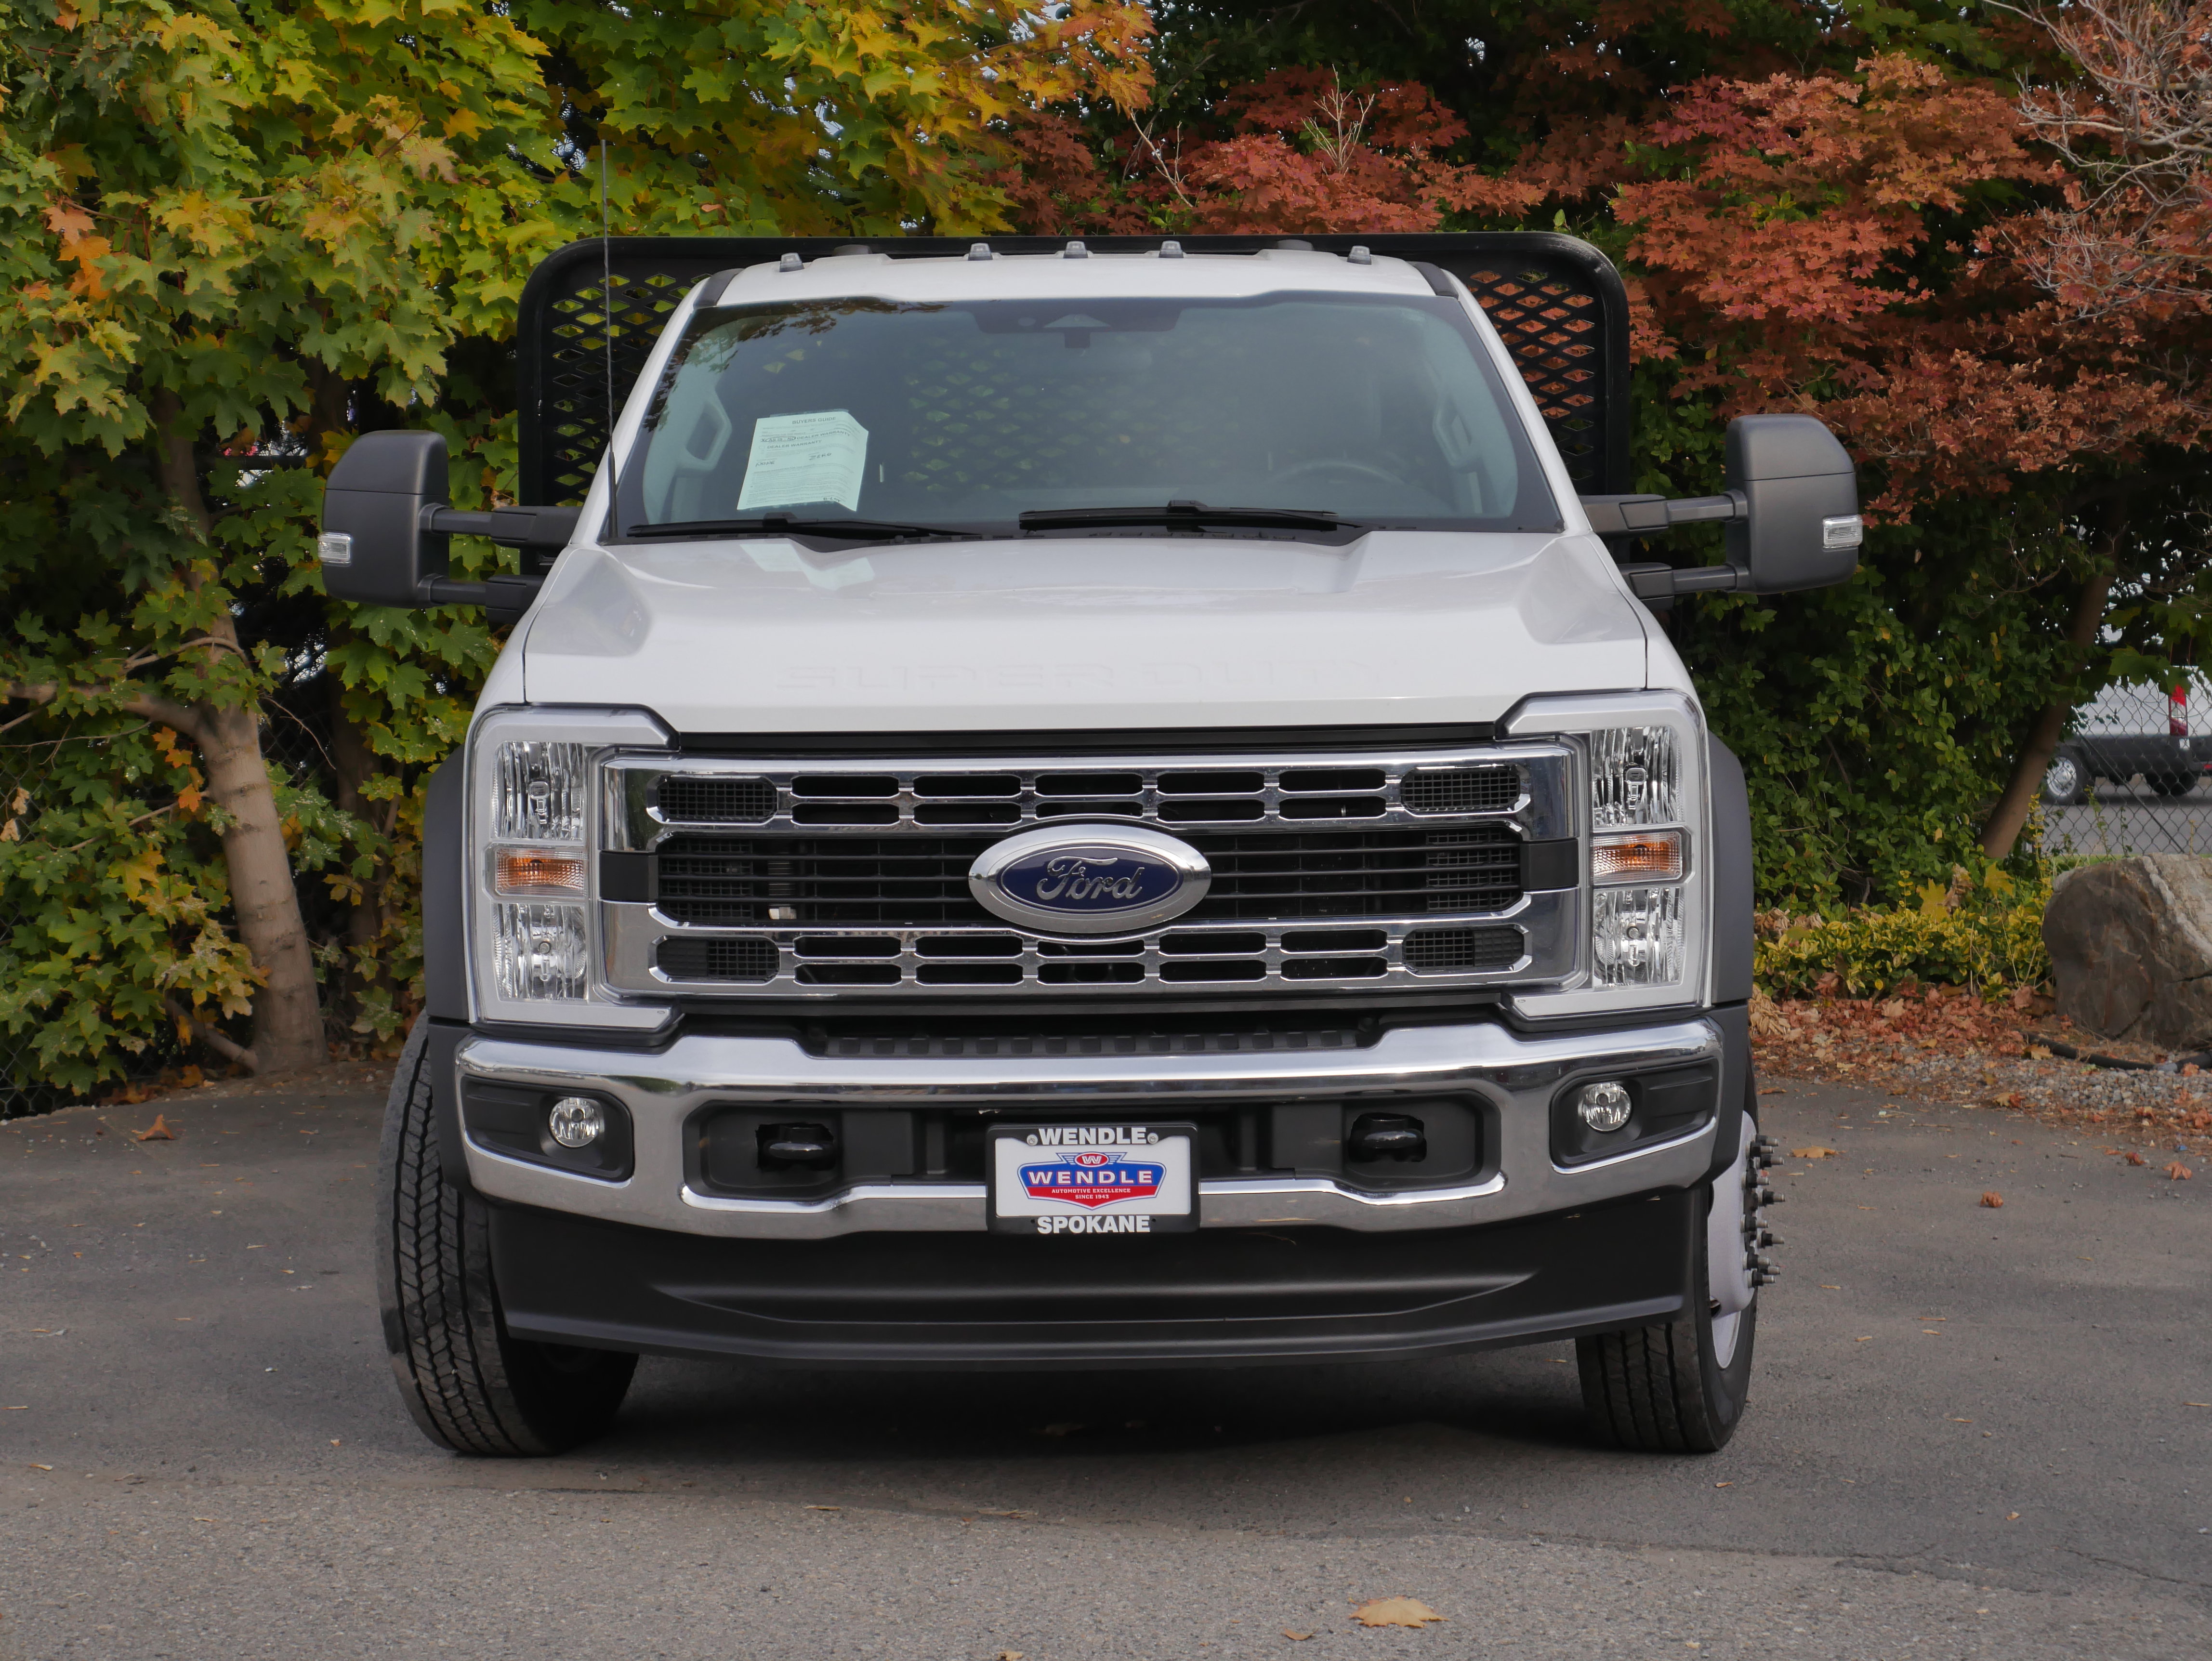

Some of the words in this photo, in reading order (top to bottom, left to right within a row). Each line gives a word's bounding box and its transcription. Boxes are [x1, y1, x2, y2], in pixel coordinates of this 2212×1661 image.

[774, 662, 1117, 691] SUPER
[1136, 658, 1399, 686] DUTY
[1036, 856, 1145, 900] Ford
[1039, 1127, 1146, 1145] WENDLE
[1081, 1156, 1102, 1164] W
[1028, 1170, 1153, 1185] WENDLE
[1037, 1215, 1150, 1234] SPOKANE
